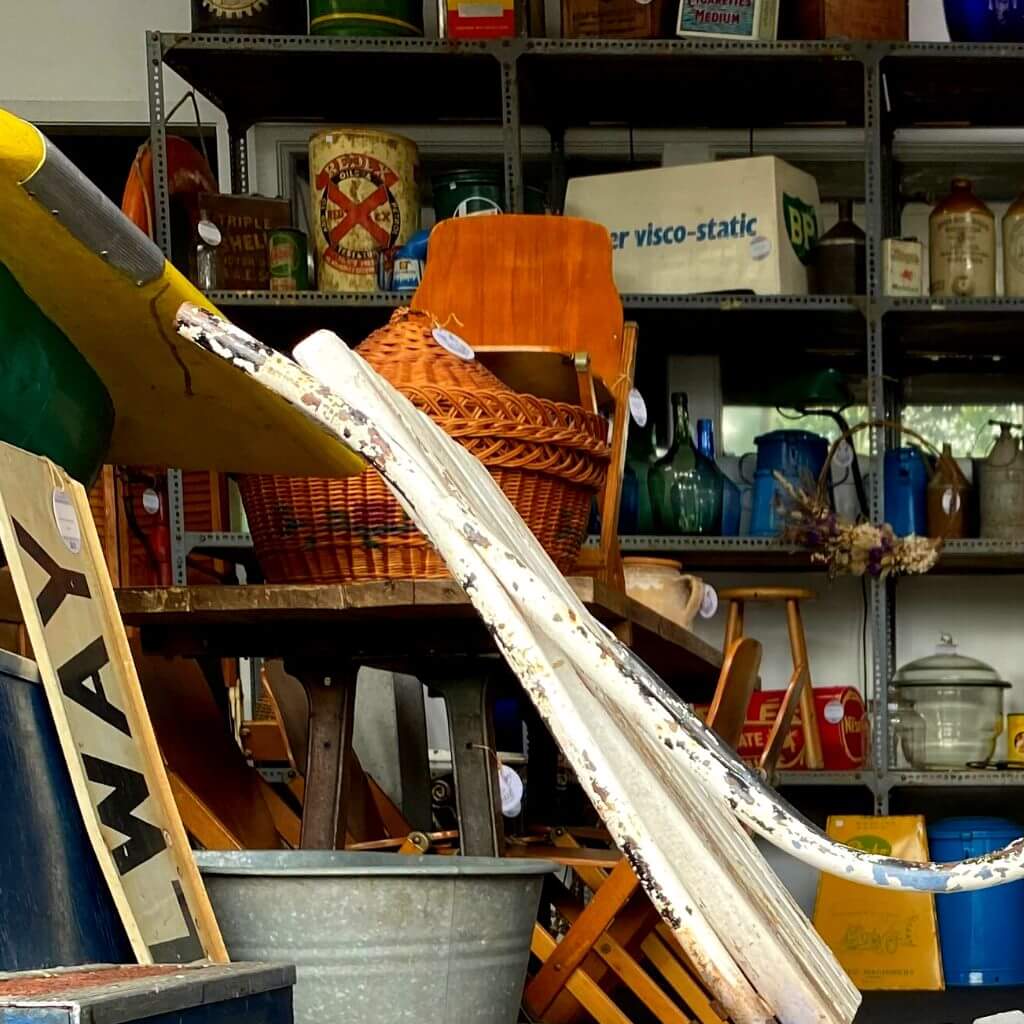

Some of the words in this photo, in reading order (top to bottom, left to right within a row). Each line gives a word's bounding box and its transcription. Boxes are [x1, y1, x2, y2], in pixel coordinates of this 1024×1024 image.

[694, 10, 741, 25] MEDIUM
[634, 212, 758, 247] visco-static
[788, 206, 815, 249] BP
